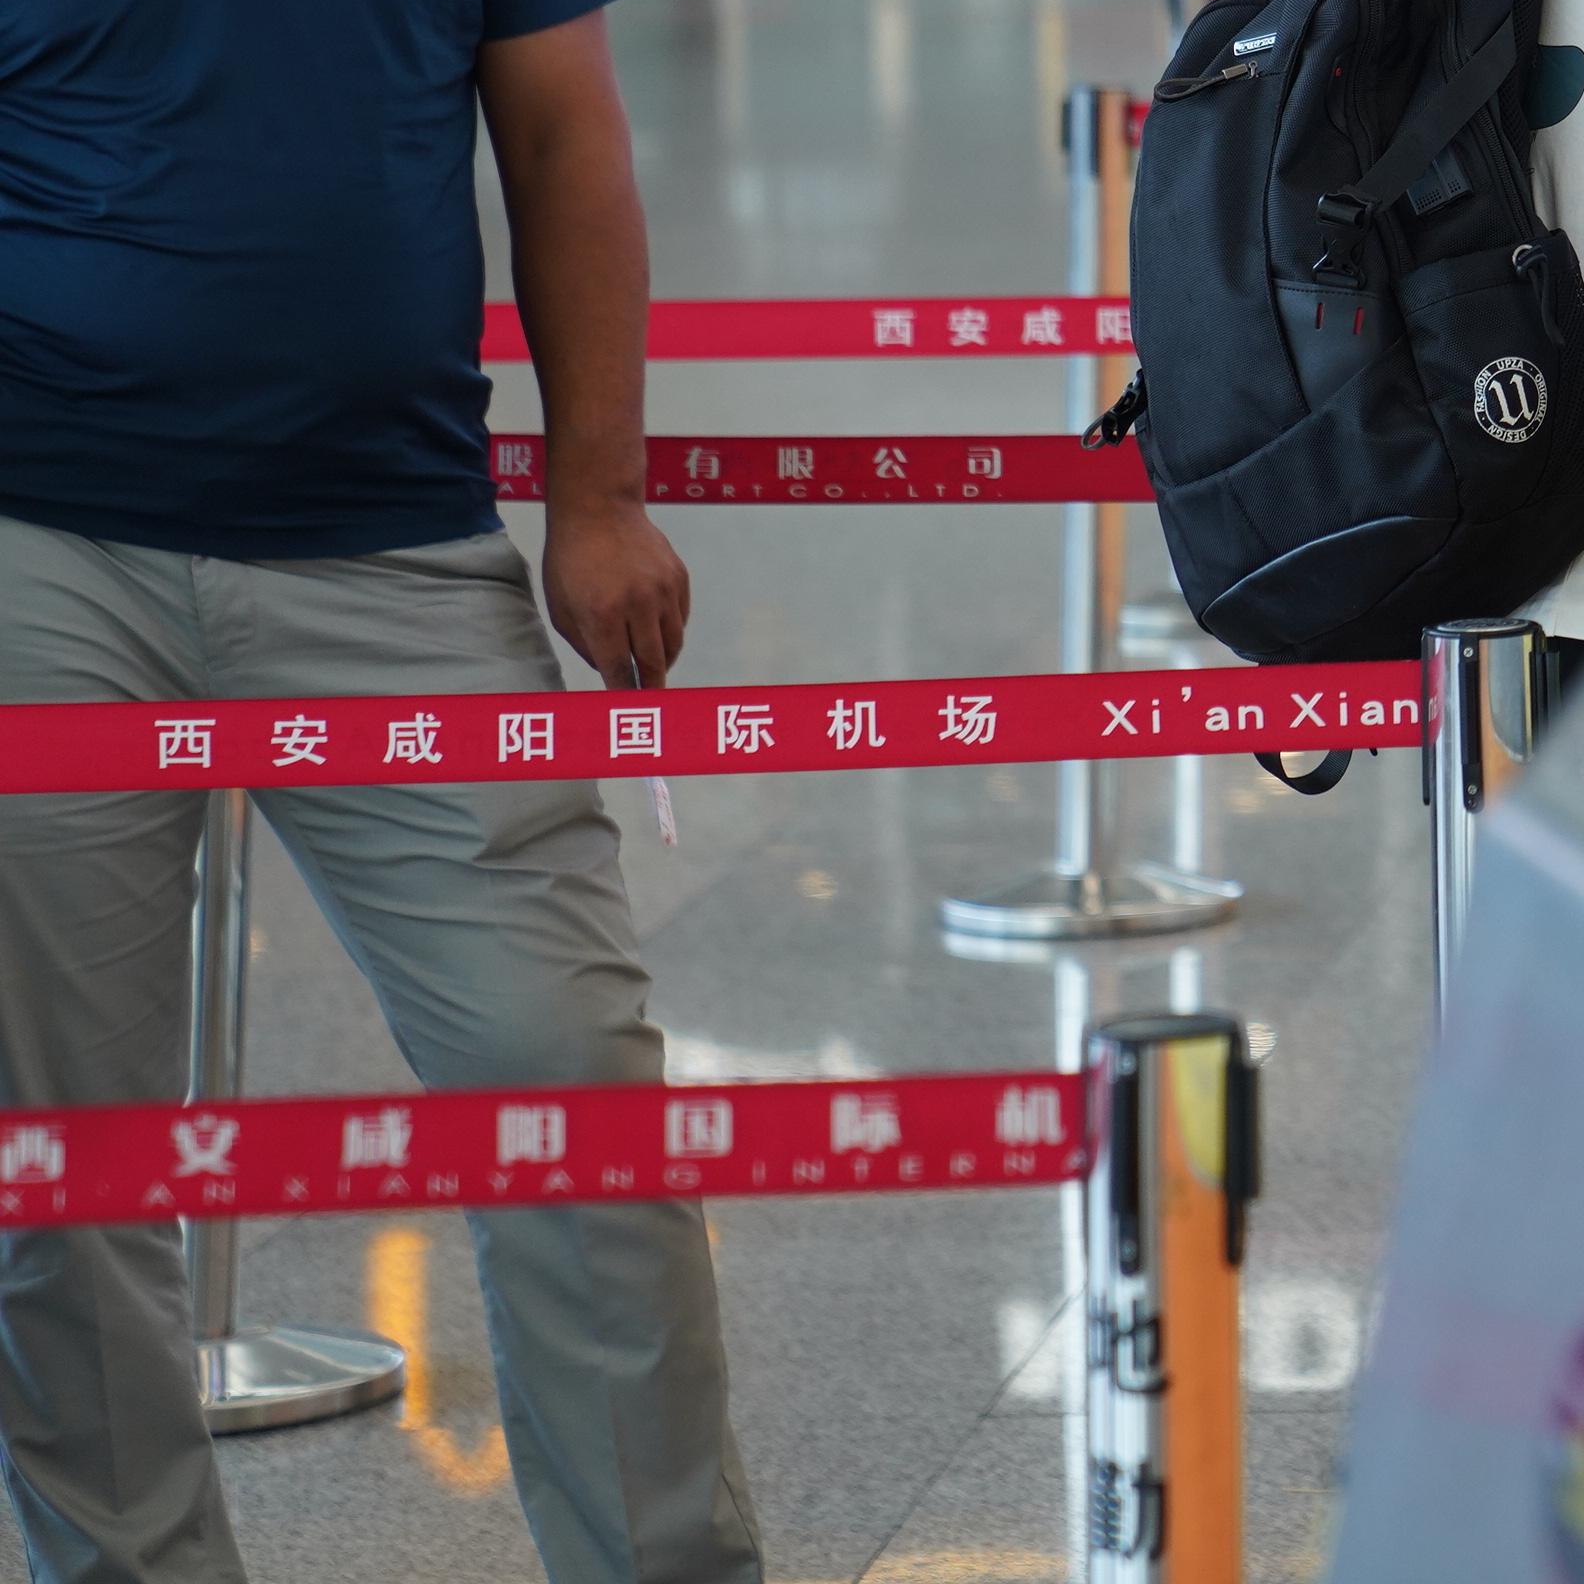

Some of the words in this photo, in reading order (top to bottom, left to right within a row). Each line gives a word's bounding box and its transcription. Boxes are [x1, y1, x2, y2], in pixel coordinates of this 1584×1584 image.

[873, 307, 1133, 346] 西安咸阳
[1496, 358, 1524, 370] UPZA
[1475, 369, 1492, 413] FASHION
[1534, 373, 1547, 422] ORIGINAL
[1487, 424, 1527, 443] DESIGN
[497, 443, 1002, 479] 股有限公司
[1101, 687, 1264, 736] Xi'an
[1289, 691, 1419, 728] Xian
[155, 696, 997, 769] 西安咸阳国际机场
[0, 1086, 1066, 1182] 西安咸阳国际机
[285, 1162, 701, 1199] XIANYANG
